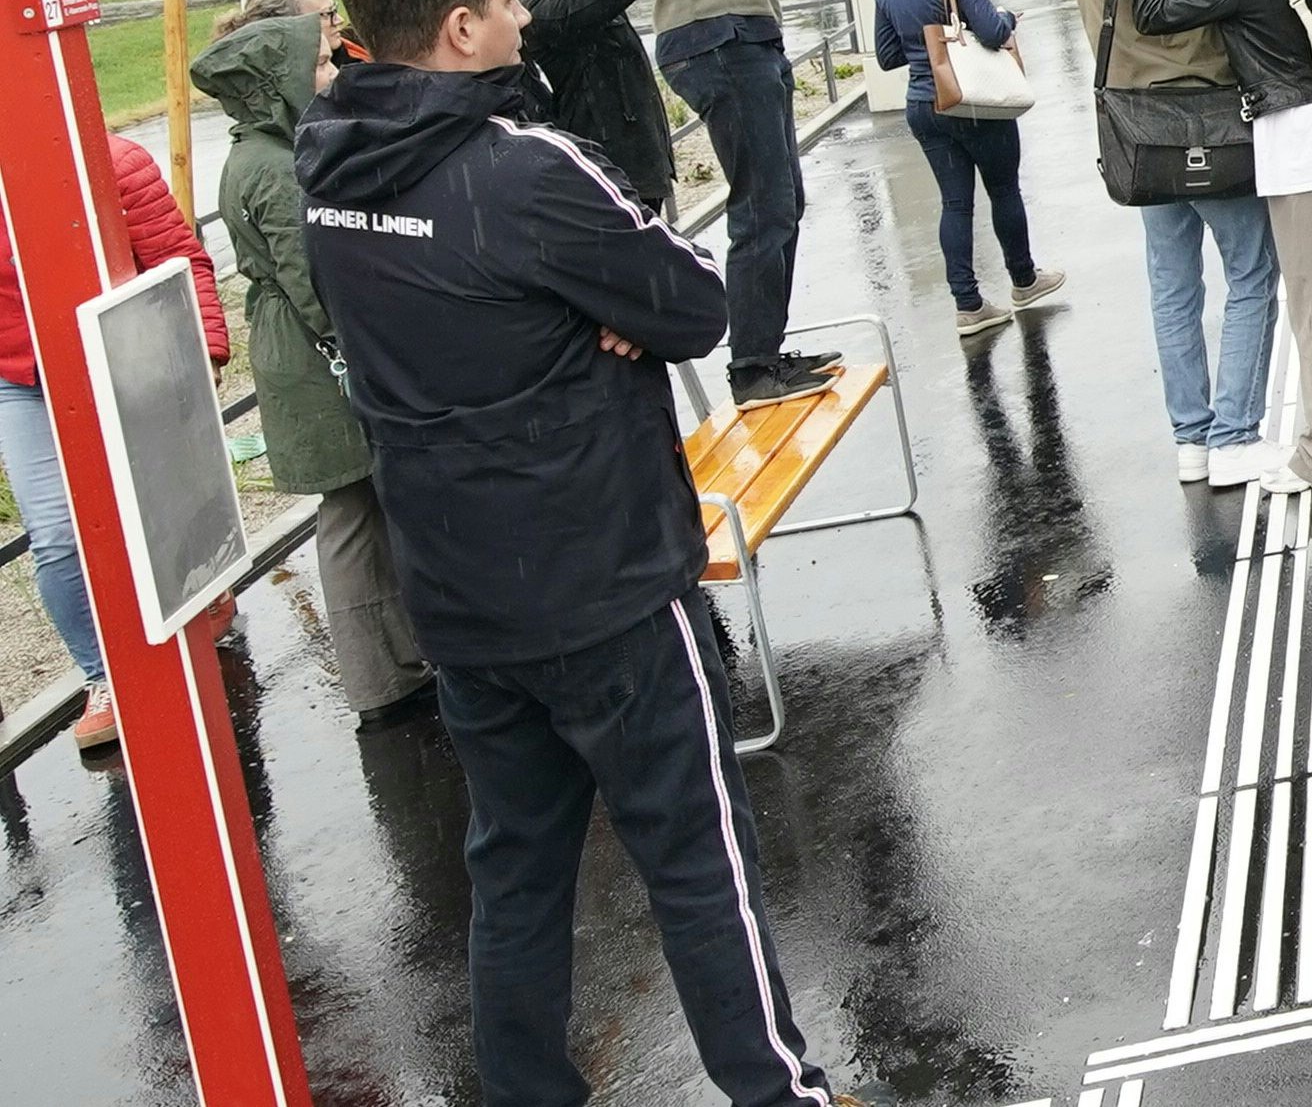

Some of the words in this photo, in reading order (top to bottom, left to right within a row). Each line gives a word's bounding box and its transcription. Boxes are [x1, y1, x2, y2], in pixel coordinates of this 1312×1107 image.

[45, 0, 58, 20] 27
[306, 206, 369, 231] WIENER
[371, 212, 434, 239] LINIEN
